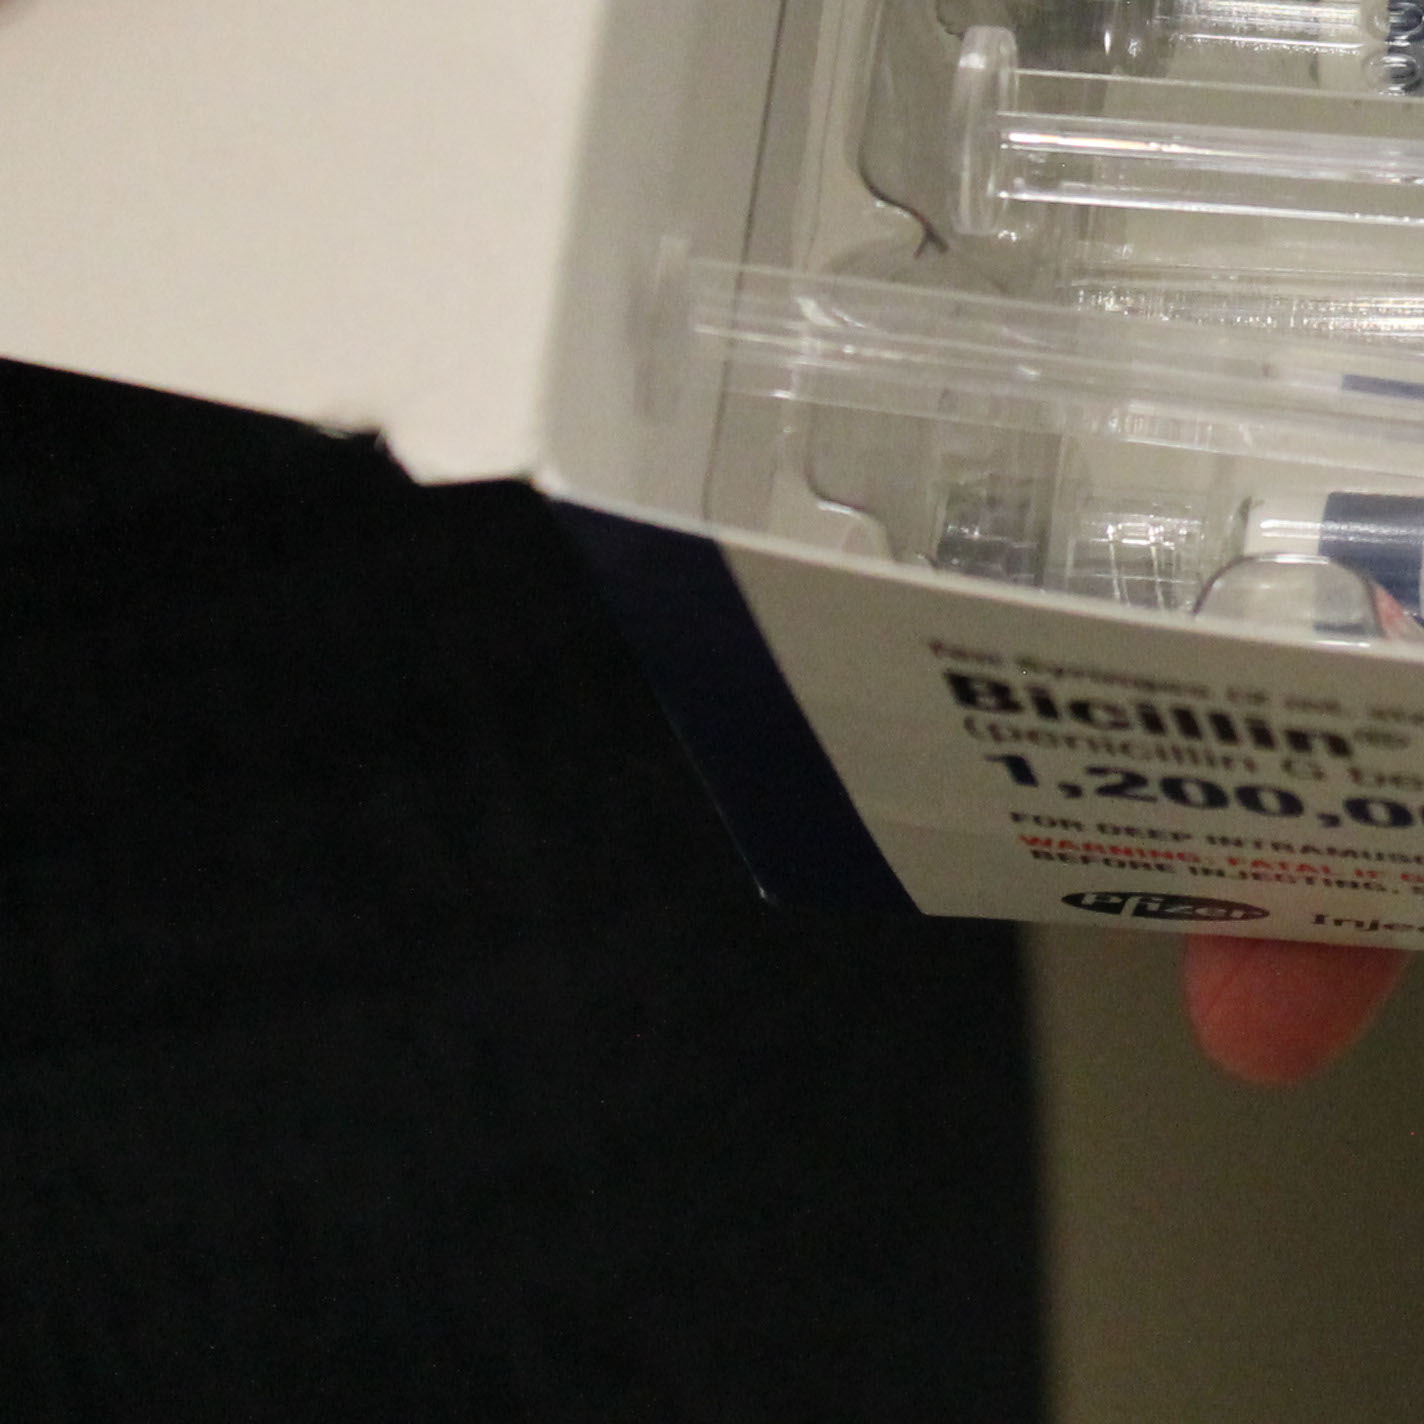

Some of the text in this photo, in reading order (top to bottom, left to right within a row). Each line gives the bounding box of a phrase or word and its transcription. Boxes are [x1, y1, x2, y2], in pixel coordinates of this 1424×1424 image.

[1009, 811, 1085, 833] FOR
[1097, 822, 1193, 844] DEEP
[1079, 892, 1263, 920] Pfizer
